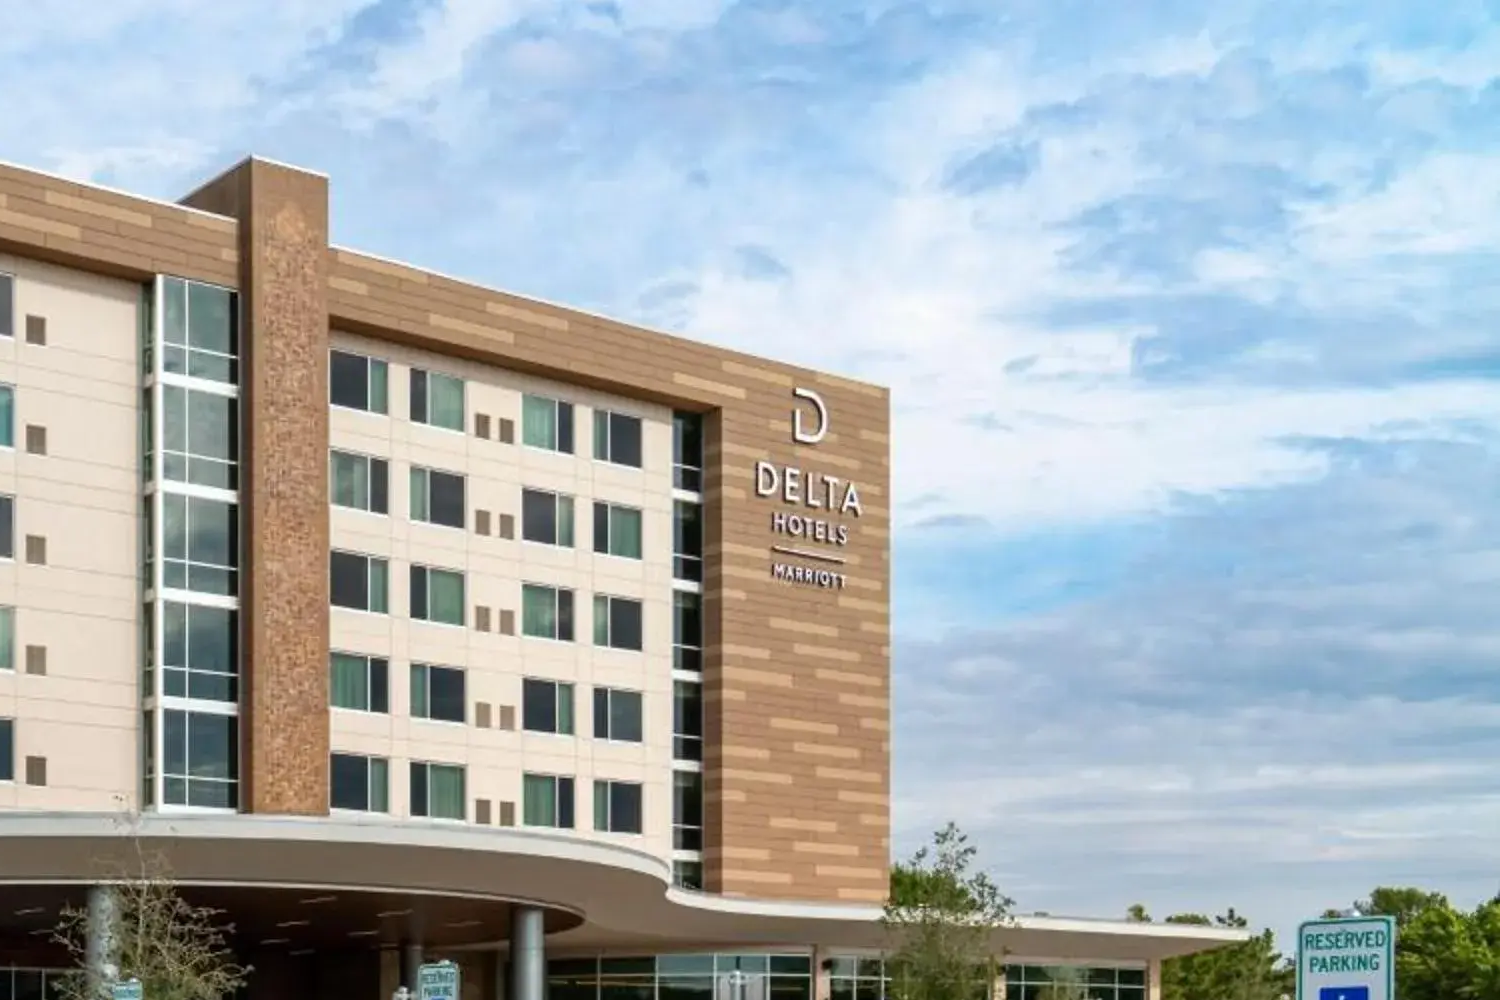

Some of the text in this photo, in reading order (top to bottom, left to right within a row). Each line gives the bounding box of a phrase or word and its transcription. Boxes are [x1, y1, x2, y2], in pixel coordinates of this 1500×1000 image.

[757, 461, 862, 516] DELTA
[773, 512, 847, 545] HOTELS
[773, 563, 847, 588] MARRIOTT
[1305, 930, 1386, 950] RESERVED
[1309, 954, 1380, 973] PARKING
